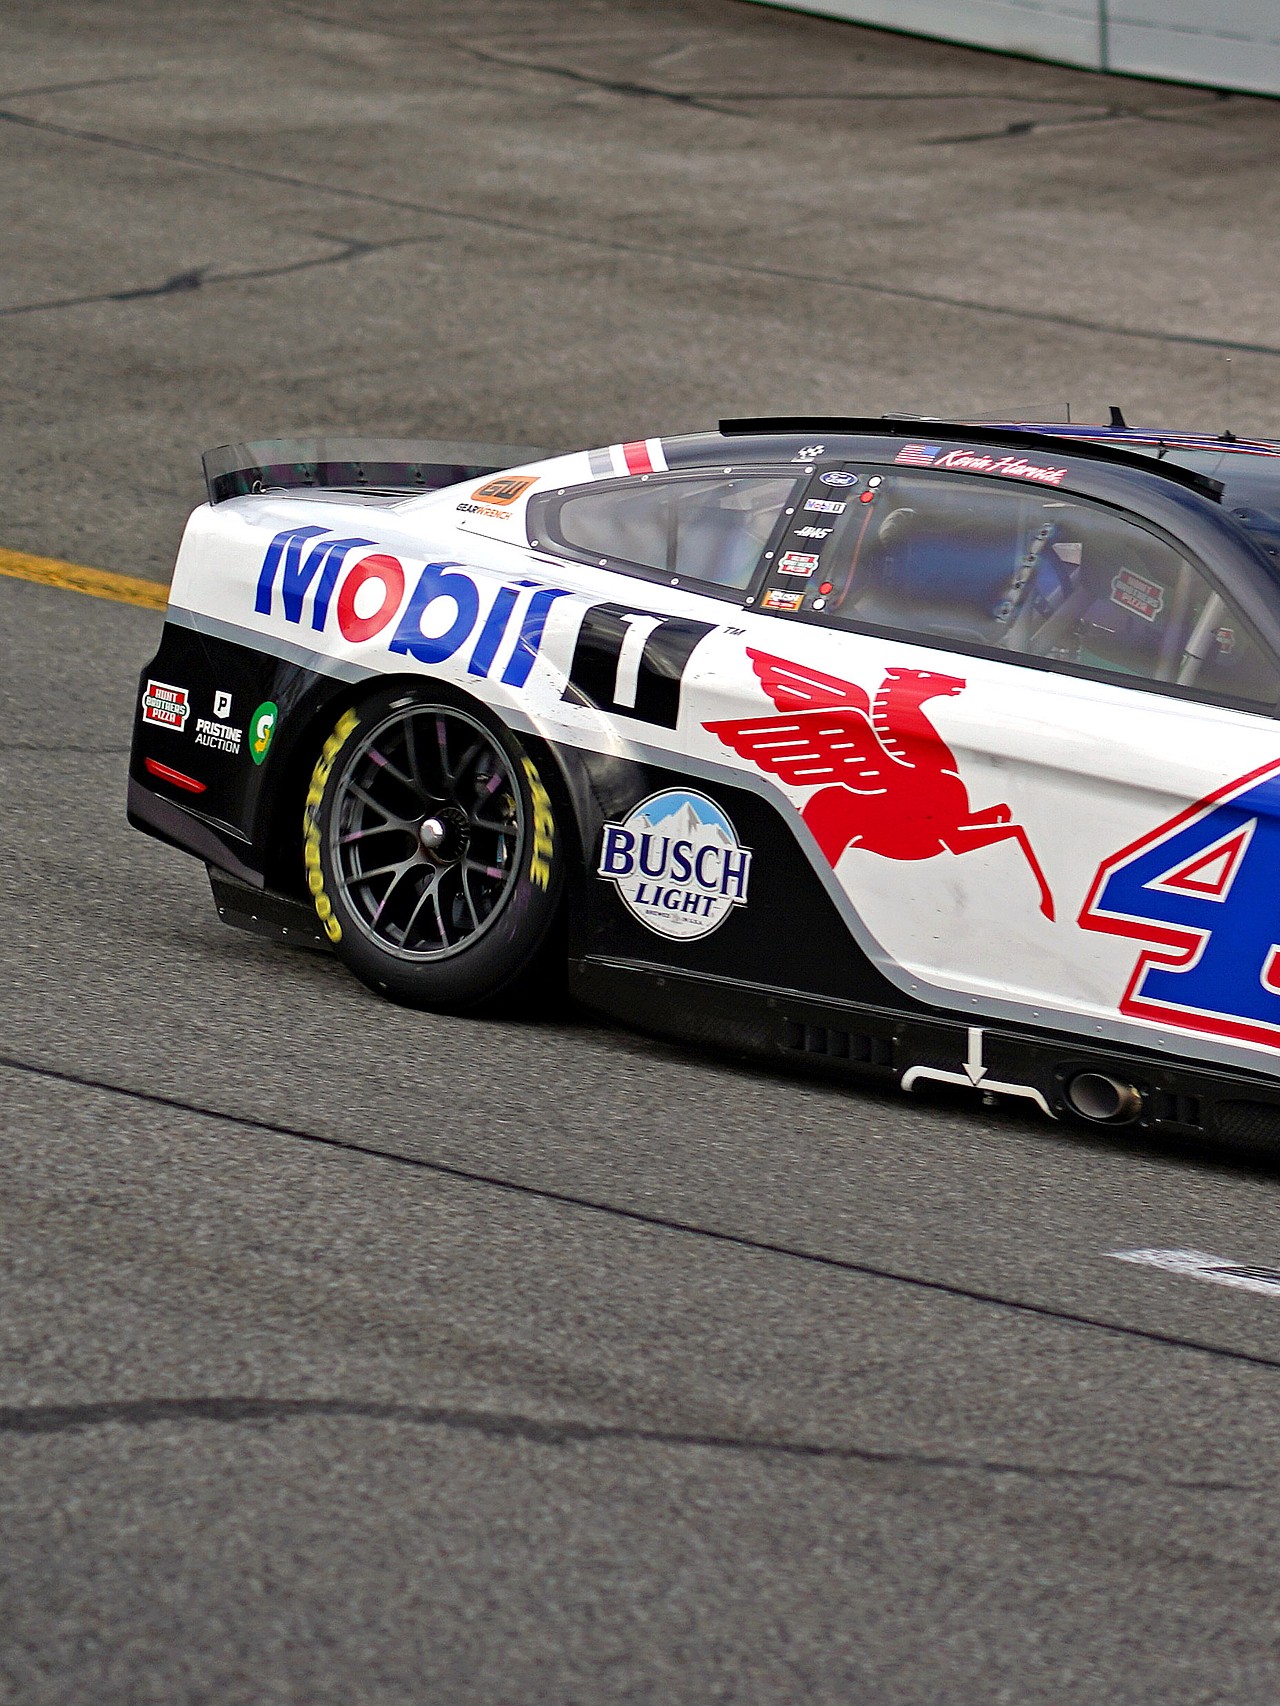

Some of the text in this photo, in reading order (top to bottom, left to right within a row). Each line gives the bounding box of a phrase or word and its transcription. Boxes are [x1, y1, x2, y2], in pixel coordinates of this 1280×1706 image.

[934, 449, 993, 472] Kevin
[456, 503, 512, 520] GEARWRENCH
[255, 526, 577, 688] Mobil
[155, 688, 178, 701] HUNT
[145, 696, 186, 717] BROTHERS
[152, 708, 177, 723] PIZZA
[195, 719, 243, 743] PRISTINE
[194, 733, 241, 755] AUCTION
[600, 827, 750, 900] BUSCH
[633, 883, 718, 917] LIGHT
